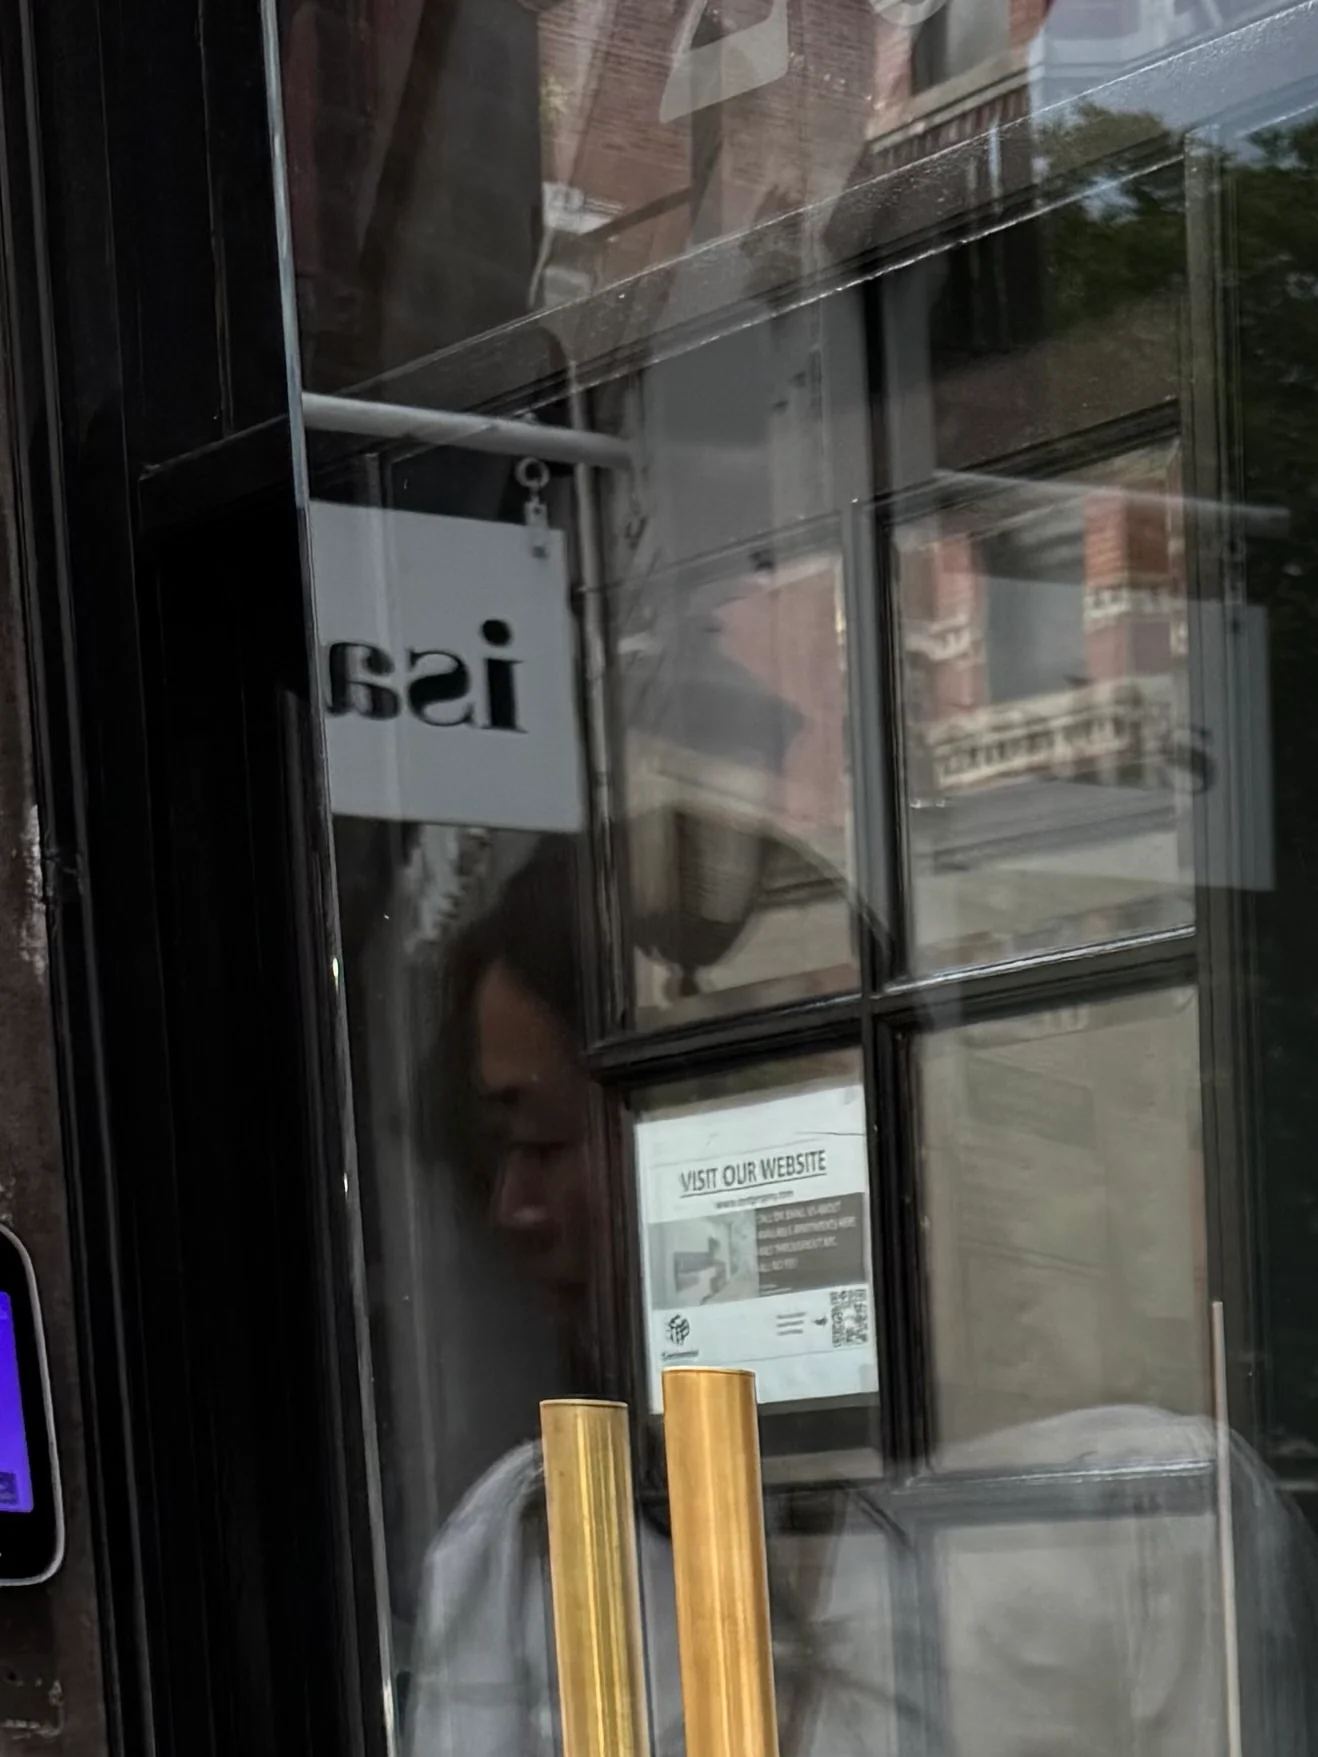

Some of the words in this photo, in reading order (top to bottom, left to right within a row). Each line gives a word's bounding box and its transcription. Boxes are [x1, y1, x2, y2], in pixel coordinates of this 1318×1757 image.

[680, 1167, 718, 1193] VISIT
[723, 1160, 757, 1187] OUR
[760, 1149, 826, 1180] WEBSITE
